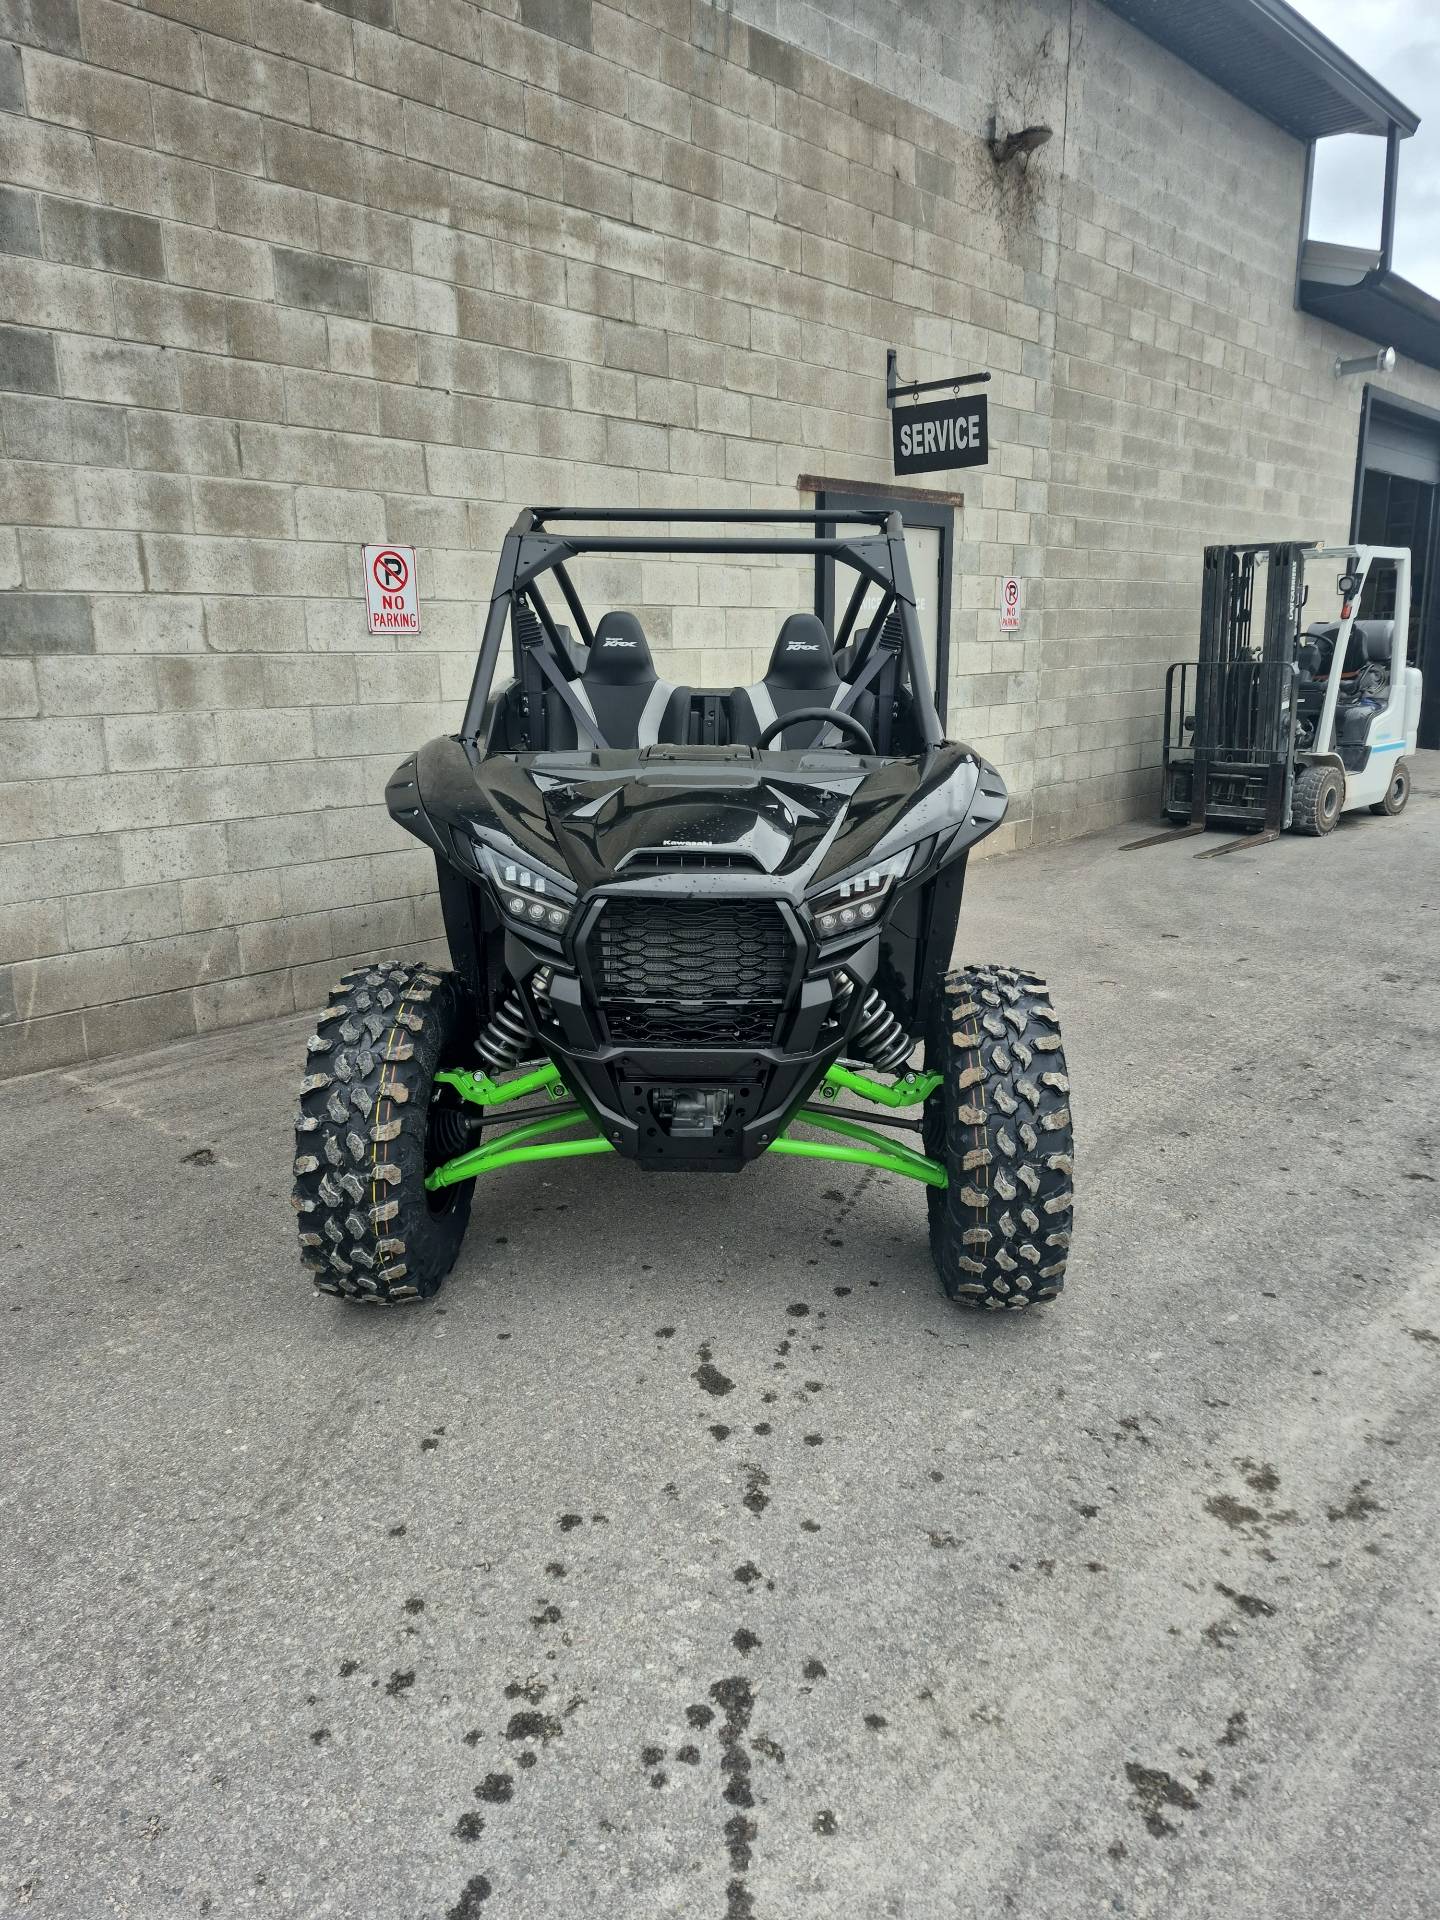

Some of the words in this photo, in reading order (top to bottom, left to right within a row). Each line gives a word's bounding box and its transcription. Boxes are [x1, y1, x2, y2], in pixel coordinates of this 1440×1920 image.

[900, 415, 980, 457] SERVICE
[382, 595, 405, 610] NO
[1006, 607, 1016, 617] NO
[373, 612, 417, 628] PARKING
[662, 839, 713, 848] Kawasaki
